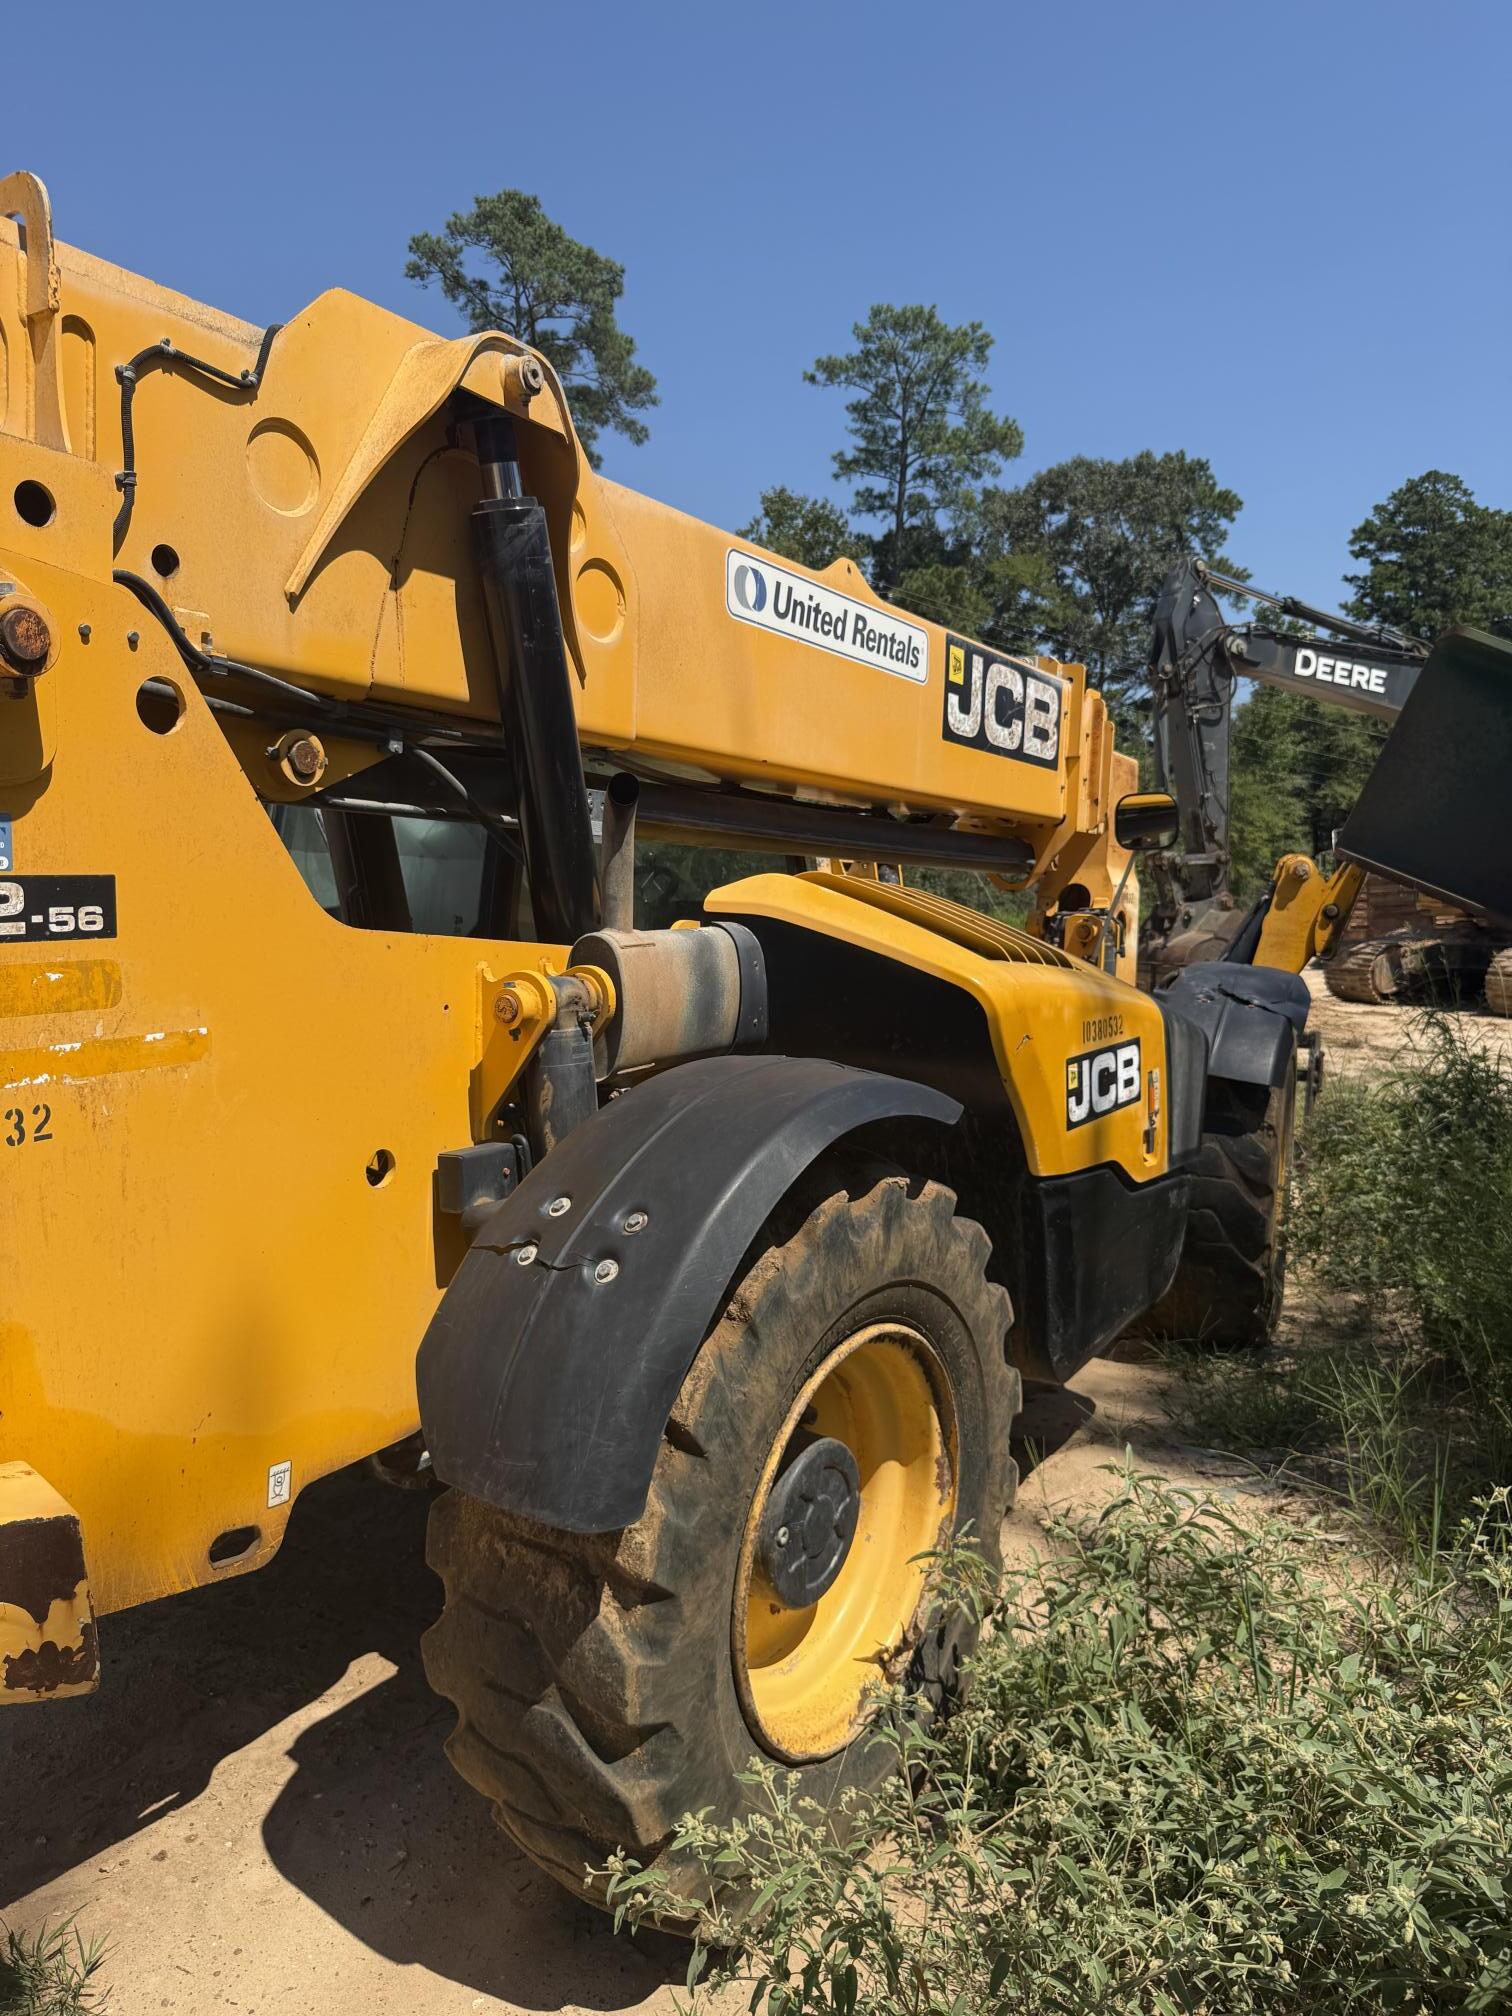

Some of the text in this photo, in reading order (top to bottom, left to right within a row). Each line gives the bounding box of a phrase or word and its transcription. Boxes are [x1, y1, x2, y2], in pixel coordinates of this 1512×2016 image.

[773, 580, 920, 669] United Rentals
[1294, 648, 1388, 693] DEERE
[947, 653, 1059, 760] JCB
[1083, 1015, 1123, 1044] 10380532
[1068, 1044, 1140, 1123] JCB
[5, 1103, 53, 1146] 32
